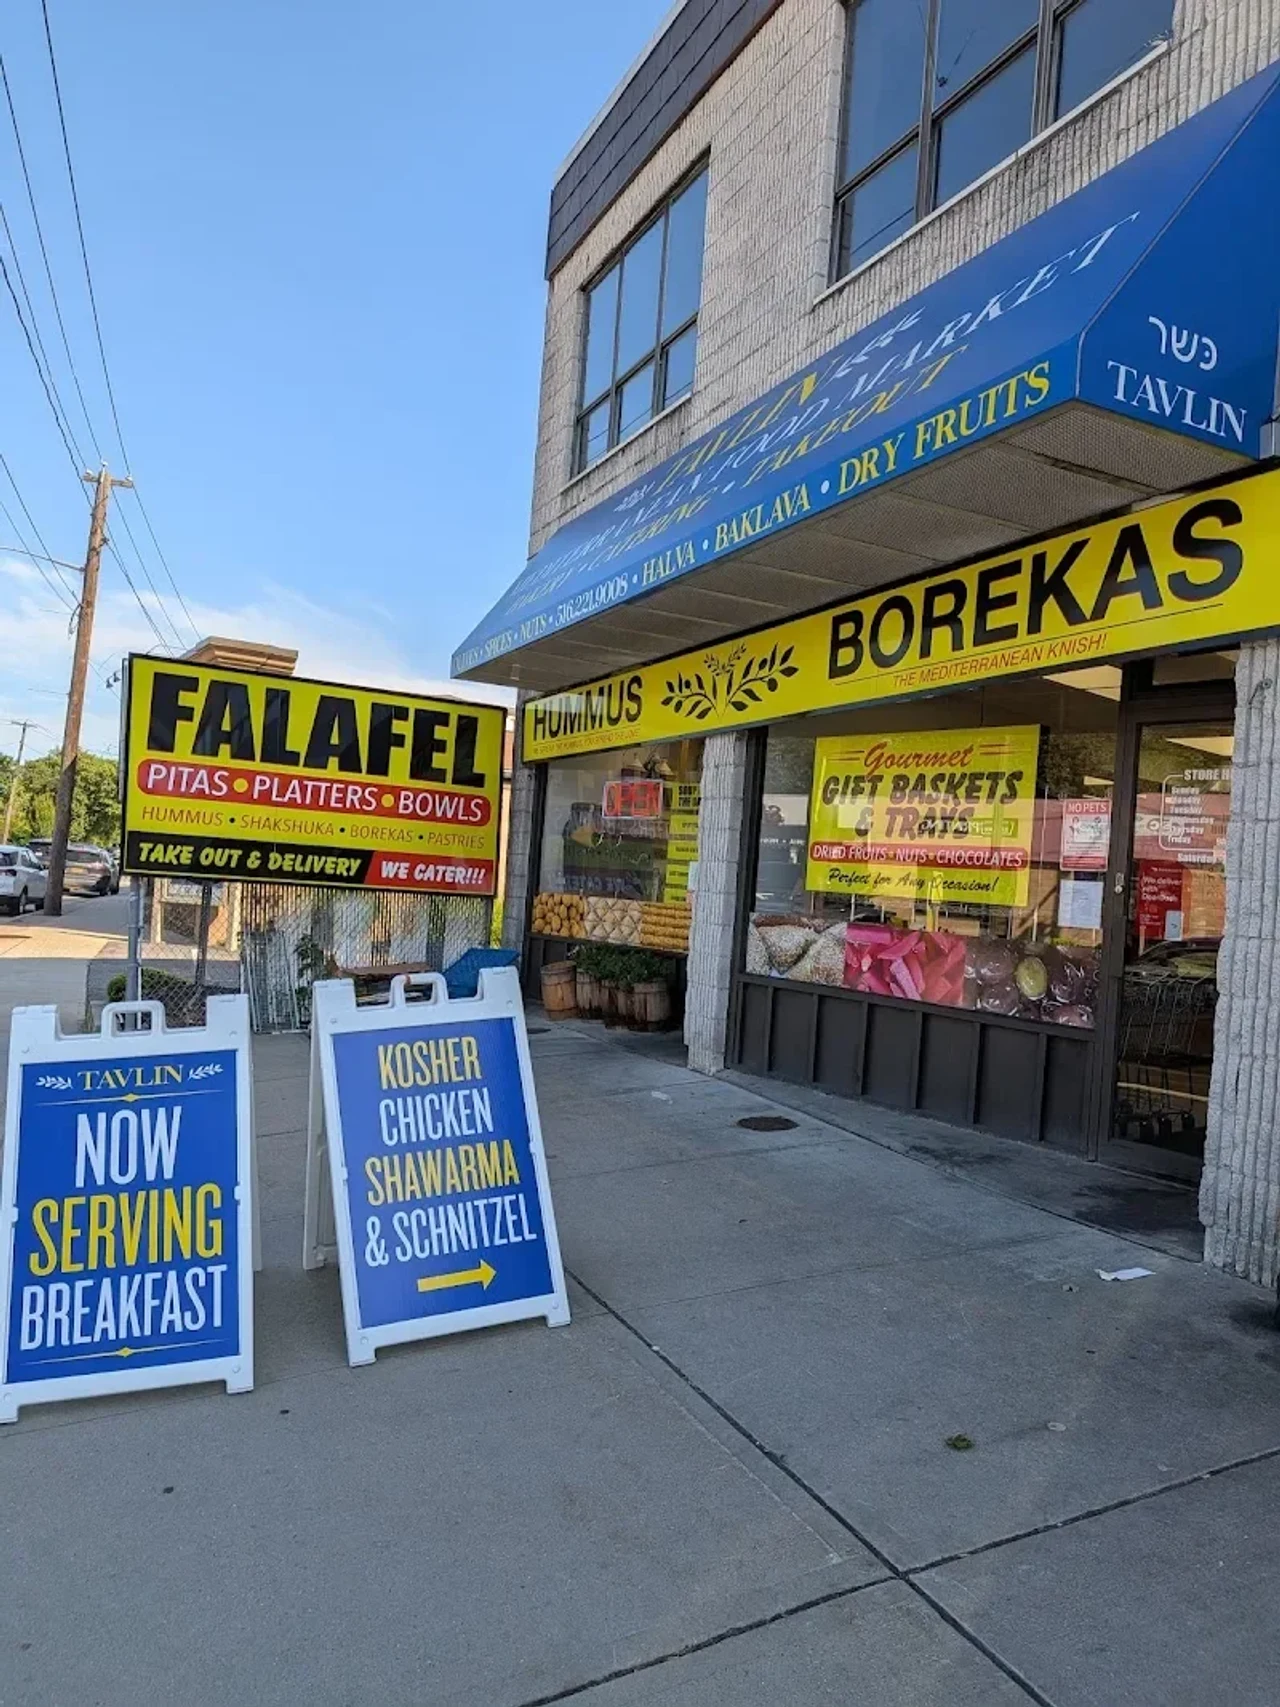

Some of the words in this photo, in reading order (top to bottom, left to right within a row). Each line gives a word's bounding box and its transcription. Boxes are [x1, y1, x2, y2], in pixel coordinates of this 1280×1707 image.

[711, 398, 830, 482] FOOD
[836, 211, 1139, 409] MARKET
[654, 355, 838, 494] TAVLIN
[742, 345, 968, 487] TAKEOUT
[1107, 360, 1248, 443] TAVLIN
[519, 614, 547, 642] NUTS
[641, 540, 695, 586] HALVA
[714, 484, 810, 553] BAKLAVA
[837, 432, 904, 496] DRY
[912, 361, 1050, 461] FRUITS
[828, 498, 1244, 680] BOREKAS
[892, 673, 916, 689] THE
[918, 646, 1044, 686] MEDITERRANEAN
[1045, 633, 1108, 660] KNISH!
[147, 672, 486, 788] FALAFEL
[533, 674, 643, 741] HUMMUS
[822, 774, 884, 806] GIFT
[890, 771, 1023, 807] BASKETS
[864, 741, 974, 779] Gourmet
[1184, 769, 1219, 781] STORE
[147, 763, 228, 798] PITAS
[253, 775, 378, 812] PLATTERS
[398, 791, 484, 822] BOWLS
[1068, 803, 1082, 812] NO
[1083, 802, 1106, 812] PETS
[142, 806, 224, 828] HUMMUS
[240, 814, 335, 837] SHAKSHUKA
[350, 824, 413, 843] BOREKAS
[427, 832, 485, 850] PASTRIES
[854, 807, 875, 837] &
[885, 806, 976, 840] TRAYS
[139, 842, 192, 866] TAKE
[200, 847, 239, 869] OUT
[247, 850, 263, 870] &
[268, 852, 362, 877] DELIVERY
[381, 860, 408, 879] WE
[413, 862, 485, 885] CATER!!!
[813, 844, 845, 860] DRIED
[848, 846, 888, 862] FRUITS
[895, 849, 928, 864] NUTS
[936, 849, 1023, 867] CHOCOLATES
[828, 868, 871, 886] Perfect
[873, 874, 892, 888] for
[895, 871, 925, 889] Any
[930, 873, 999, 892] Occasion!
[78, 1064, 183, 1091] TAVLIN
[378, 1036, 482, 1090] KOSHER
[379, 1088, 494, 1146] CHICKEN
[75, 1105, 182, 1188] NOW
[364, 1139, 520, 1206] SHAWARMA
[29, 1183, 223, 1277] SERVING
[364, 1216, 390, 1268] &
[393, 1193, 537, 1264] SCHNITZEL
[20, 1265, 228, 1351] BREAKFAST
